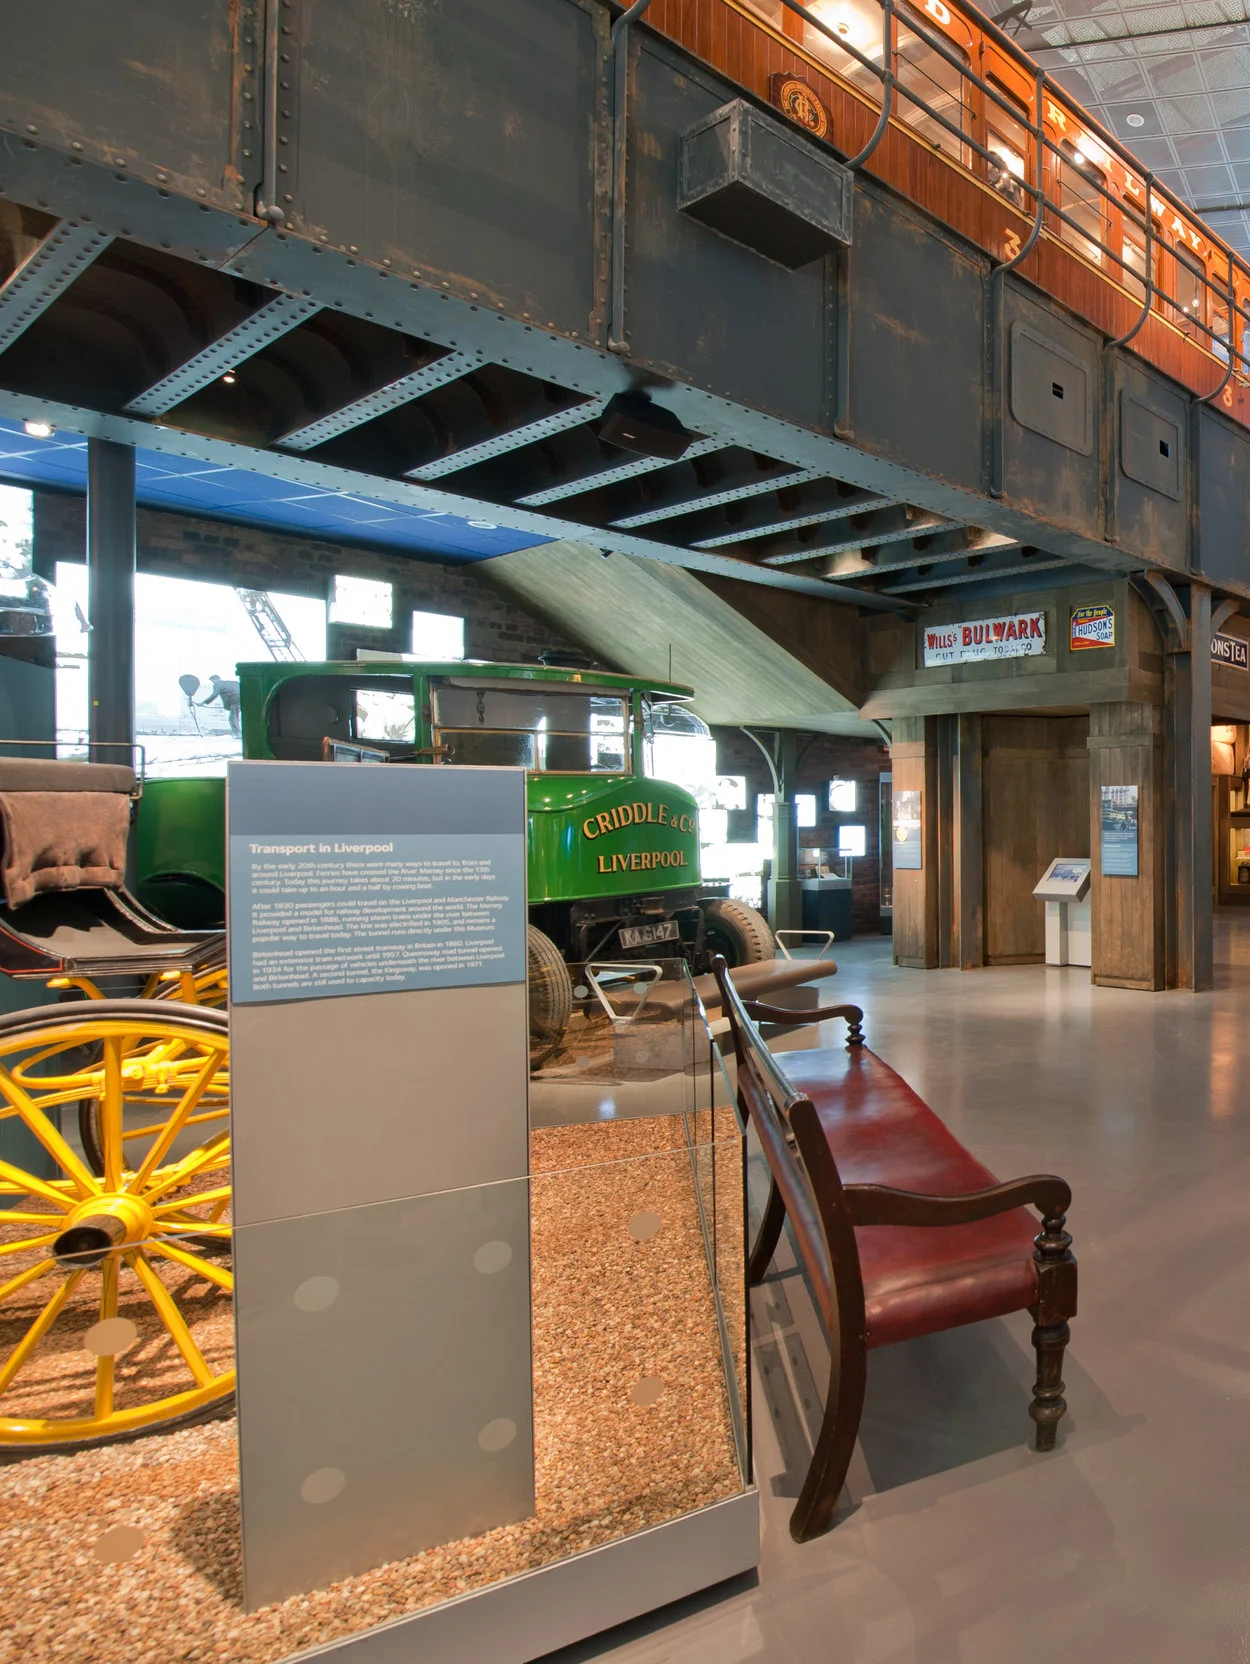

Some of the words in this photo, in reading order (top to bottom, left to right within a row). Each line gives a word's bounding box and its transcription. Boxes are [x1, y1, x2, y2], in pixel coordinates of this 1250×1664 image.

[1047, 100, 1202, 250] RILWAY
[1077, 617, 1113, 636] HUDSON'S
[1096, 631, 1113, 640] SOAP
[1230, 641, 1246, 663] TEA
[583, 802, 669, 839] CRIDDLE
[670, 815, 678, 829] &
[249, 843, 315, 856] Transport
[319, 843, 331, 853] in
[334, 842, 394, 855] Liverpool
[598, 850, 688, 874] LIVERPOOL
[624, 929, 642, 947] KA
